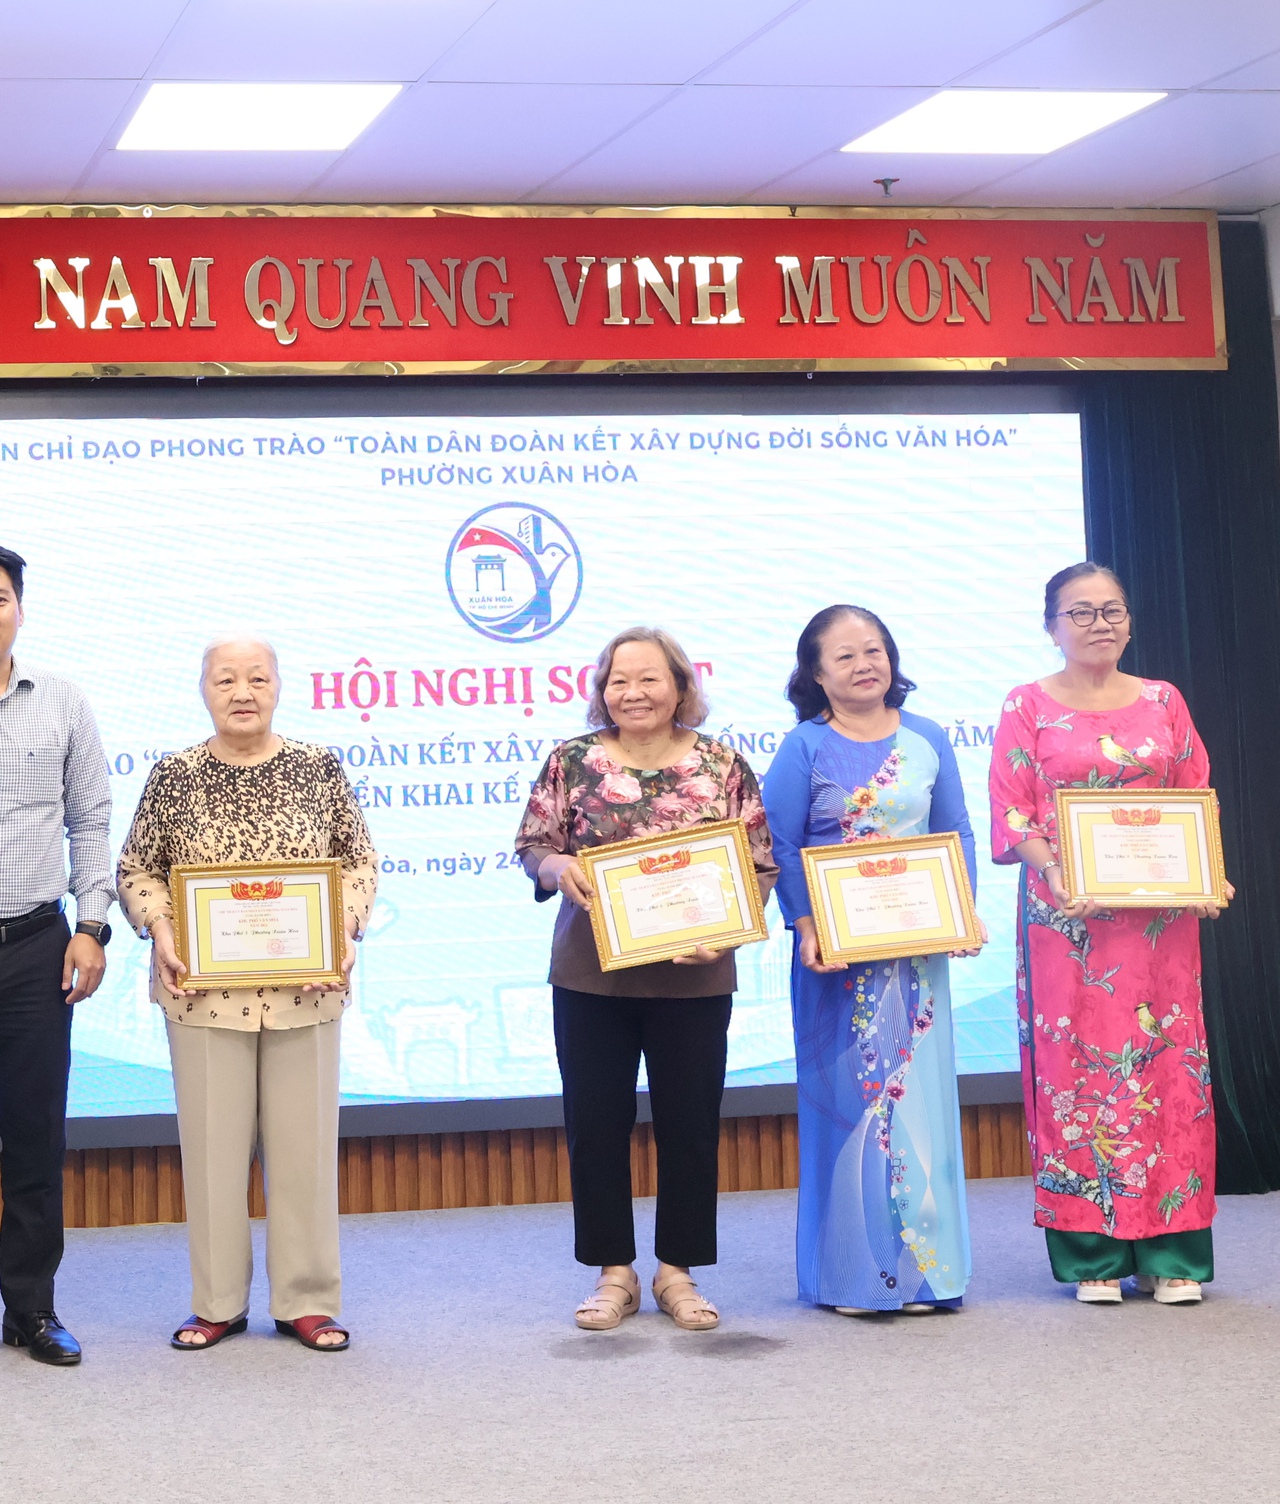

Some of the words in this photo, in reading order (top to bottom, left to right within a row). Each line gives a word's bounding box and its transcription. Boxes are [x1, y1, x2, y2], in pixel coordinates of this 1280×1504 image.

[33, 255, 218, 330] NAM
[243, 254, 514, 345] QUANG
[544, 255, 746, 326] VINH
[775, 229, 991, 324] MUÔN
[1025, 231, 1186, 323] NĂM
[28, 434, 73, 461] CHỈ
[82, 440, 141, 465] ĐẠO
[151, 437, 245, 459] PHONG
[253, 430, 326, 456] TRÀO
[427, 428, 483, 453] DÂN
[491, 426, 568, 452] ĐOÀN
[574, 421, 621, 451] KẾT
[630, 425, 680, 450] XÂY
[690, 429, 760, 455] DỰNG
[768, 424, 813, 449] ĐỜI
[821, 421, 891, 449] SỐNG
[896, 424, 950, 449] VĂN
[381, 459, 493, 487] PHƯỜNG
[502, 459, 574, 484] XUÂN
[583, 460, 638, 483] HÒA
[310, 657, 399, 722] HỘI
[412, 665, 537, 718] NGHỊ
[417, 731, 476, 766] KẾT
[482, 731, 545, 763] XÂY
[714, 723, 777, 754] ỐNG
[402, 781, 474, 807] KHAI
[482, 770, 521, 804] KẾ
[380, 854, 418, 876] òa,
[426, 851, 487, 877] ngày
